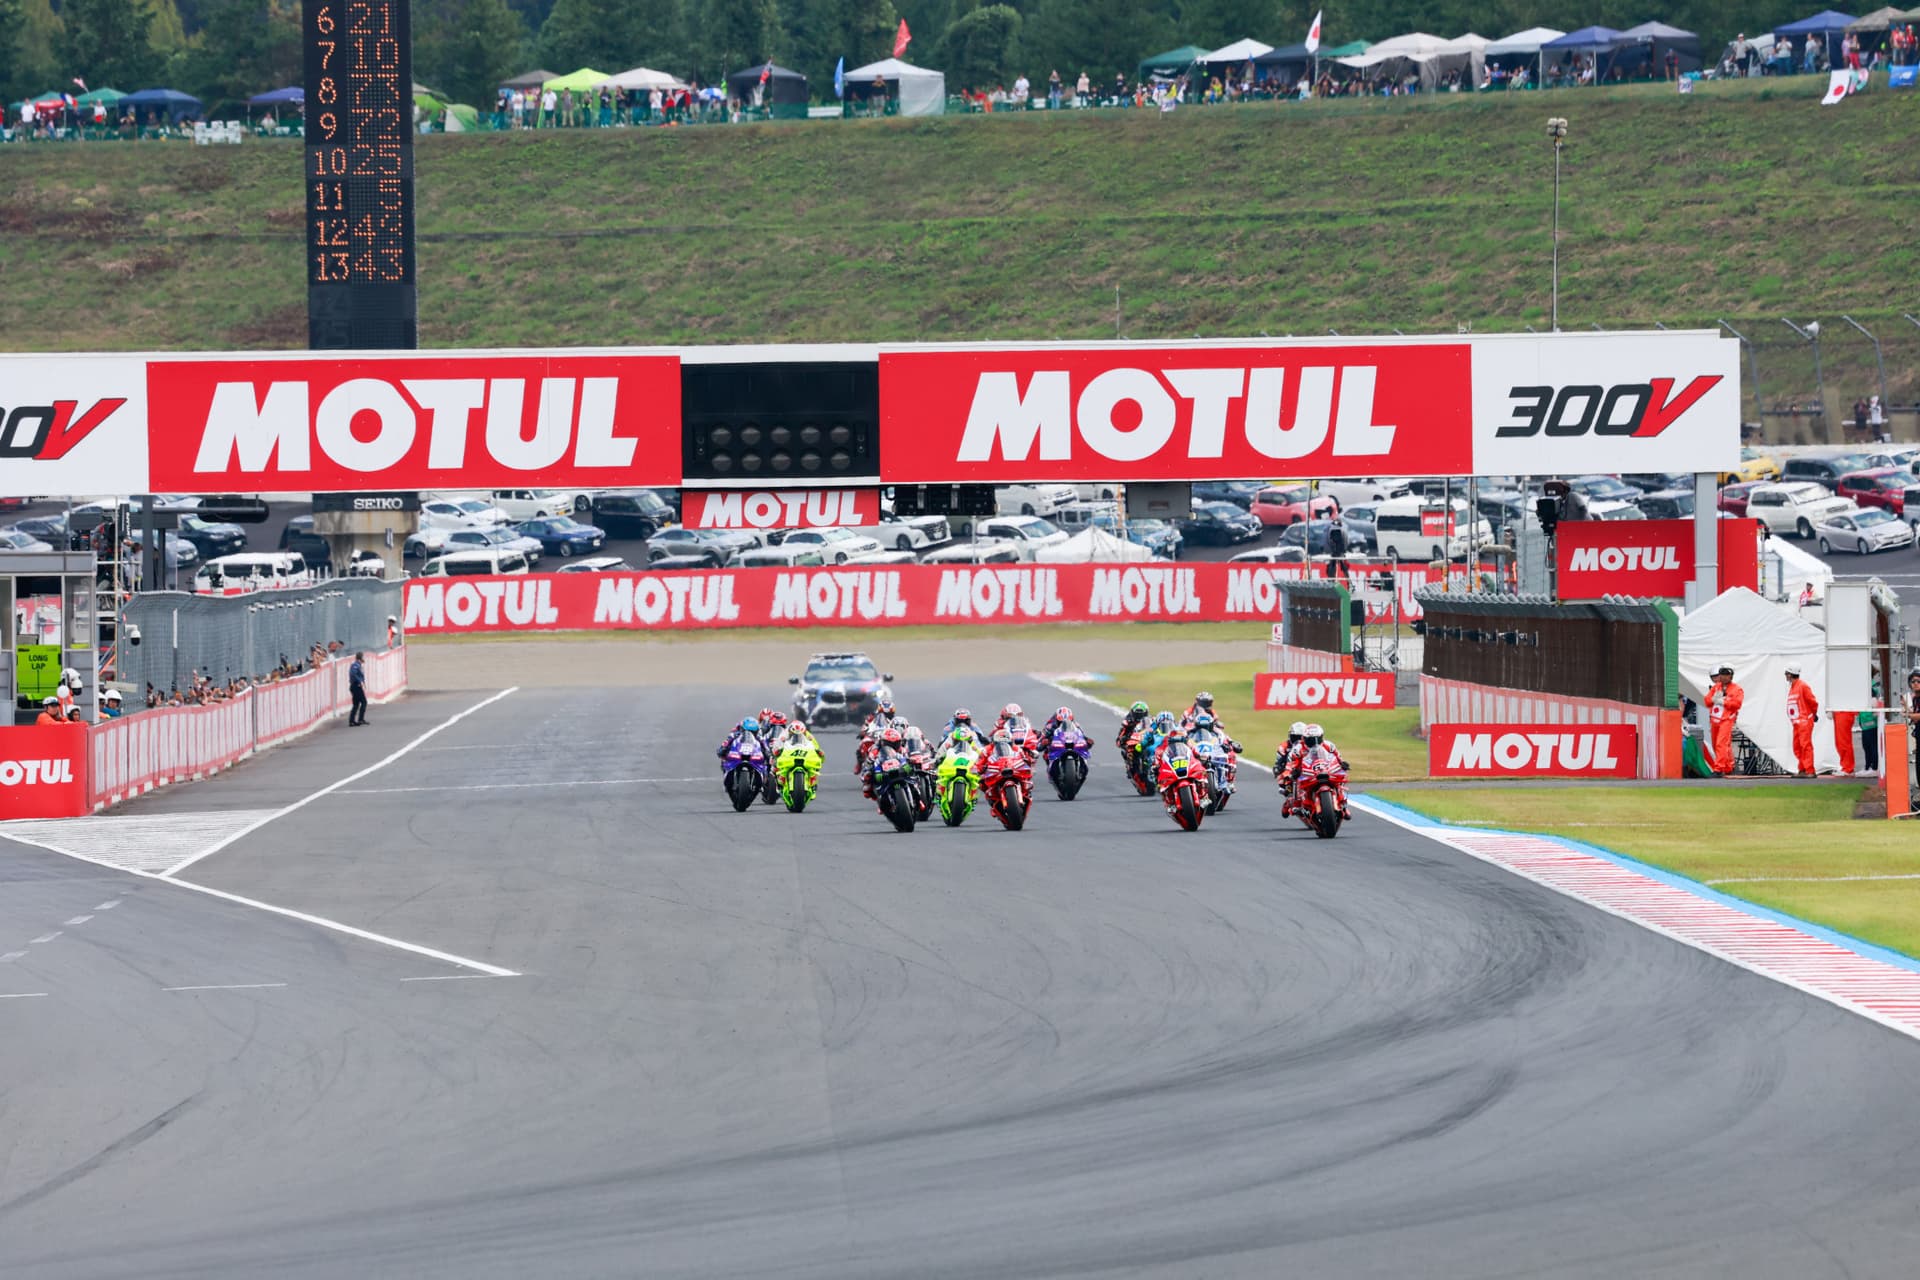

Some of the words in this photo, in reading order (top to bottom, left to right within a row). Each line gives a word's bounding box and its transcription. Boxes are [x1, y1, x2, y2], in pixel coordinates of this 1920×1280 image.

[317, 6, 335, 34] 6
[349, 2, 389, 34] 21
[318, 41, 335, 70] 7
[354, 37, 399, 69] 10
[318, 77, 337, 104] 8
[320, 112, 336, 140] 9
[352, 108, 400, 139] 72
[315, 147, 346, 175] 10
[352, 143, 401, 175] 25
[316, 182, 342, 210] 11
[379, 179, 402, 210] 5
[316, 218, 349, 246] 12
[317, 252, 349, 280] 13
[354, 249, 404, 280] 43
[956, 365, 1397, 463] MOTUL
[1495, 375, 1724, 438] 300V
[0, 398, 128, 461] 0V
[193, 377, 639, 473] MOTUL
[353, 497, 404, 510] SEIKO
[699, 491, 863, 529] MOTUL
[1423, 516, 1454, 525] MOTL
[1570, 546, 1680, 572] MOTUL
[404, 579, 558, 628] MOTUL
[594, 575, 740, 624] MOTUL
[770, 572, 907, 620] MOTUL
[935, 569, 1063, 617] MOTUL
[1088, 567, 1201, 616] MOTUL
[1225, 567, 1320, 614] MOT
[1266, 678, 1383, 706] MOTUL
[1446, 732, 1618, 770] MOTUL
[0, 758, 74, 786] OTUL
